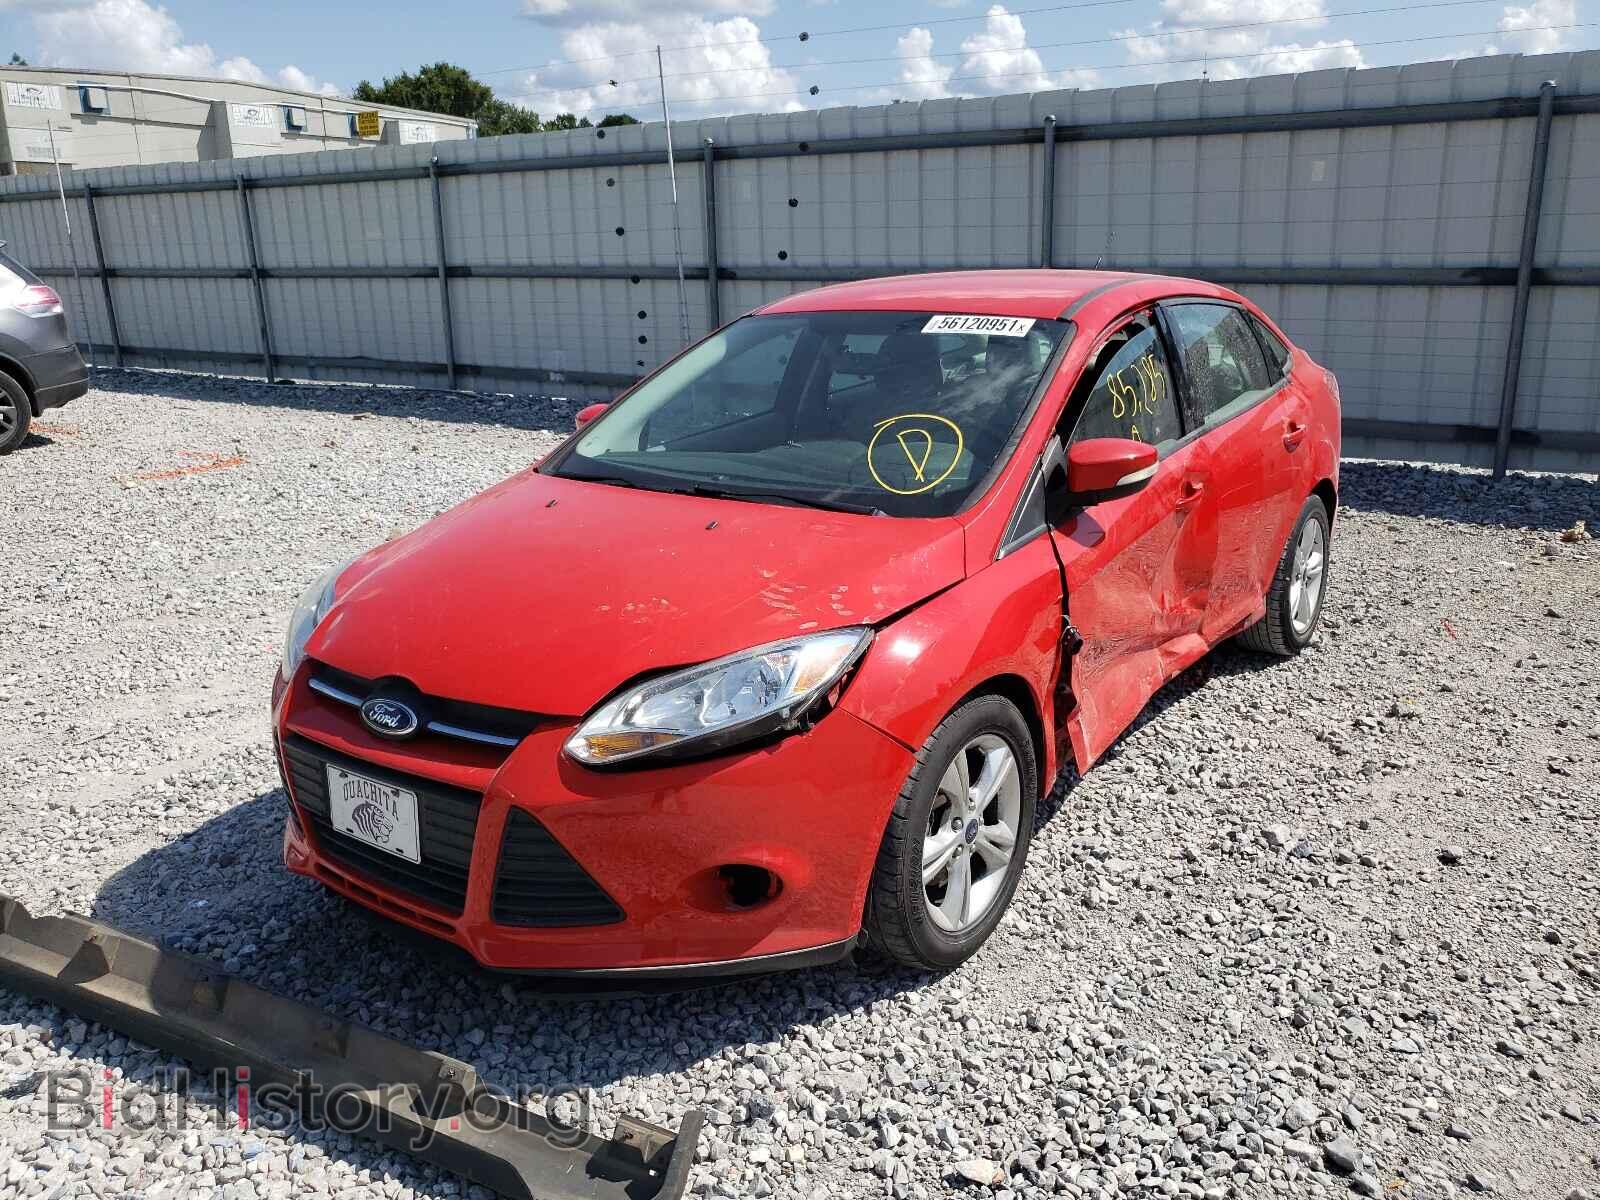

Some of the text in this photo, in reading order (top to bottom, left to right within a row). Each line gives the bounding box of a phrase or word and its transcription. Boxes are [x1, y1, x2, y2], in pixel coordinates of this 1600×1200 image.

[938, 316, 1019, 332] 56120951
[370, 703, 400, 728] Ford
[343, 780, 399, 821] OUACHITA
